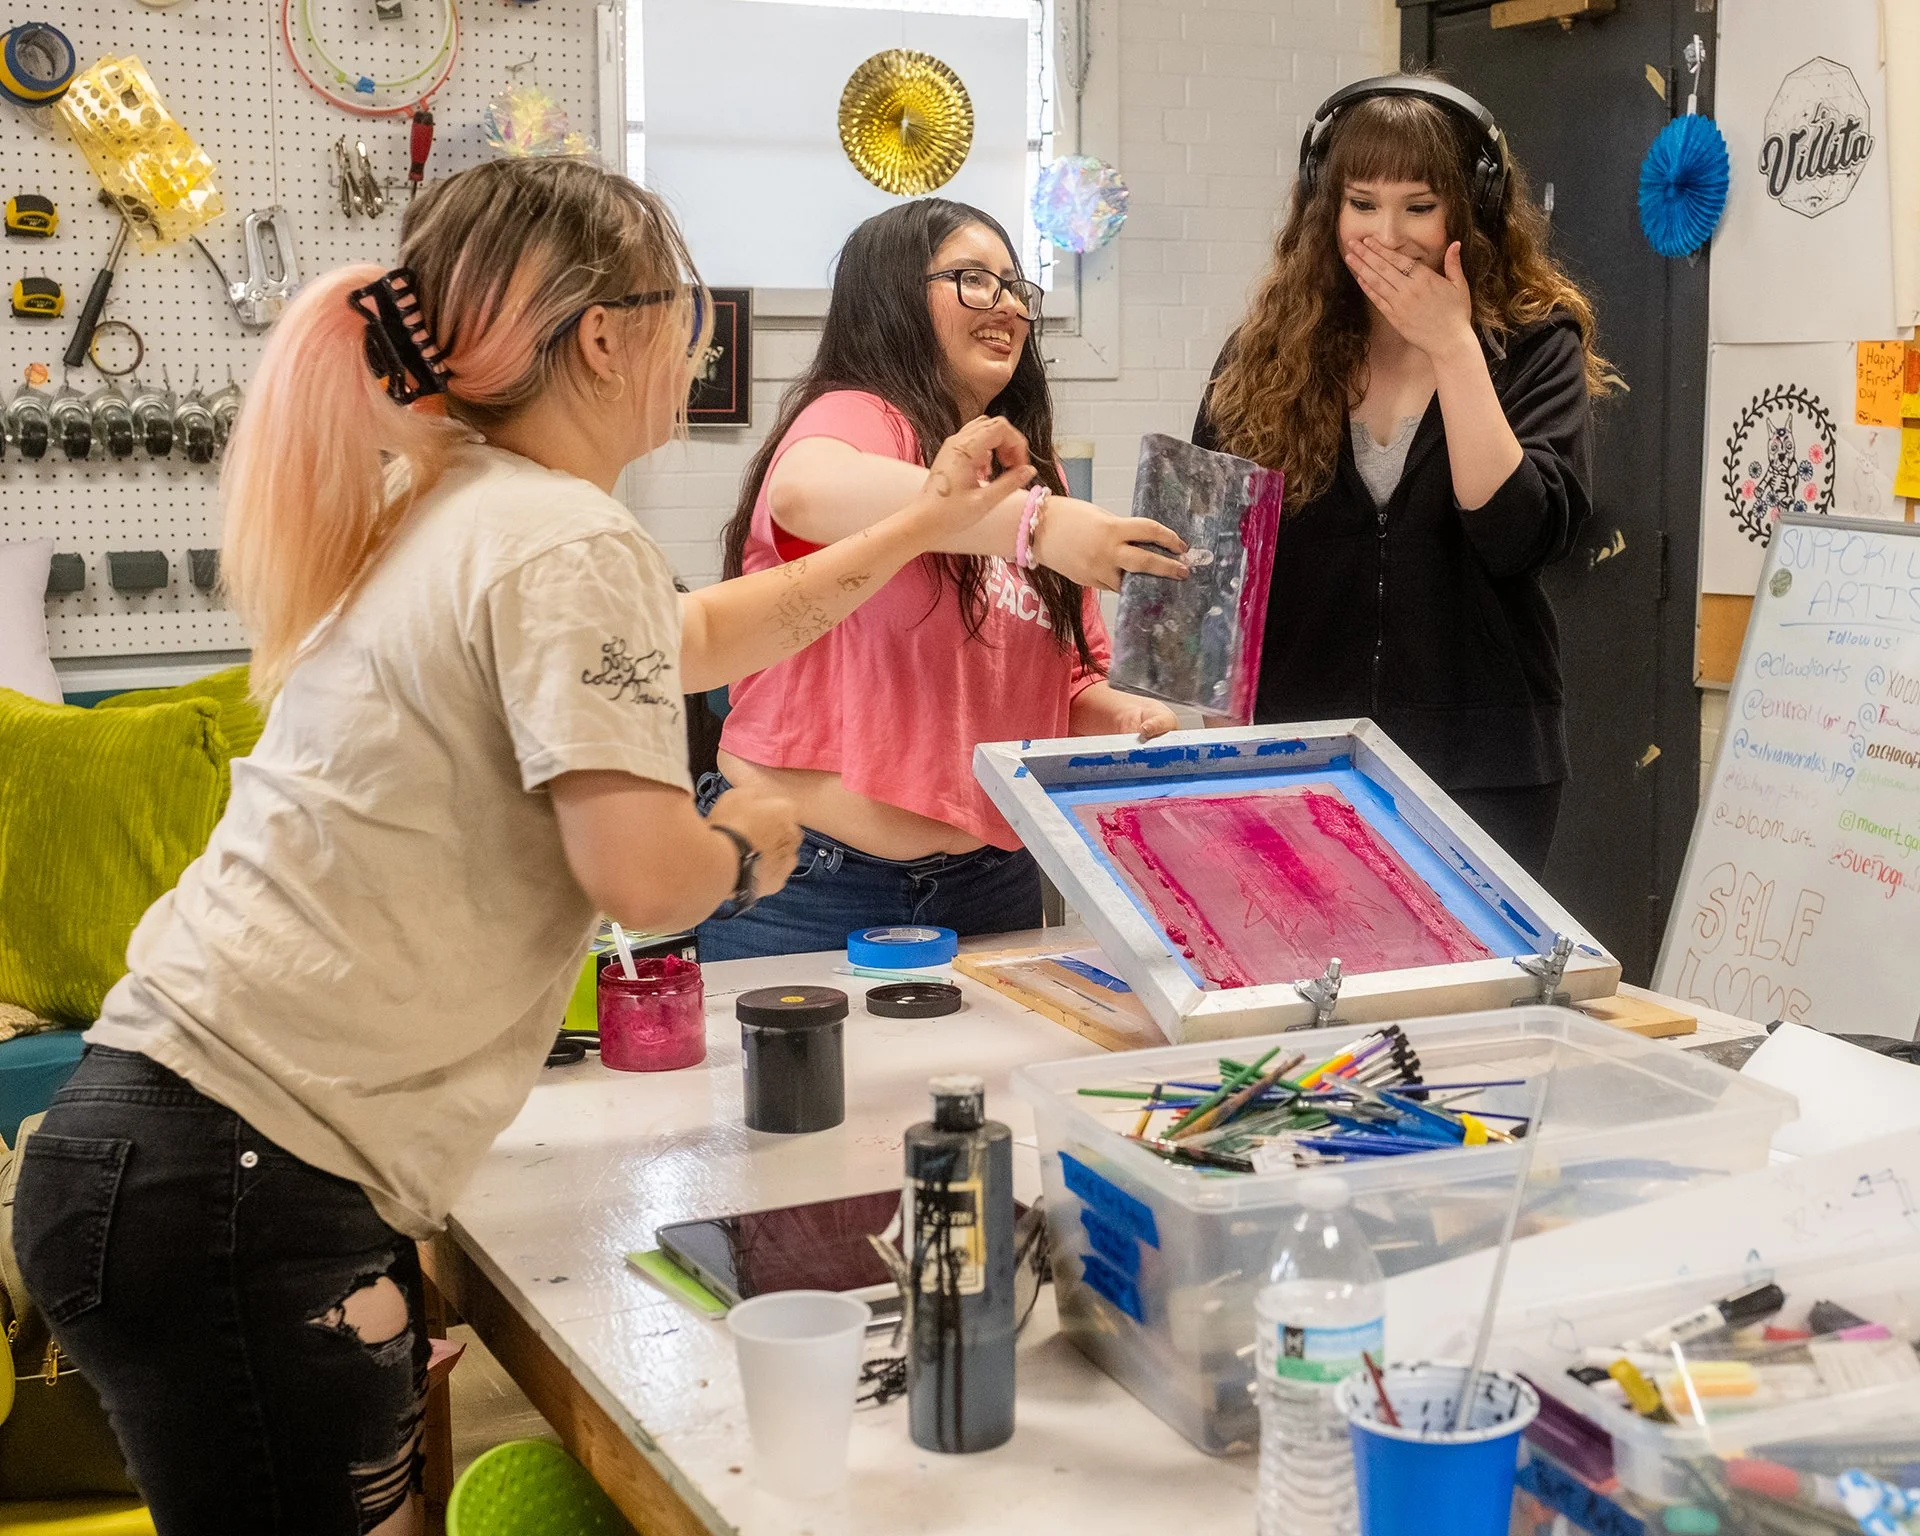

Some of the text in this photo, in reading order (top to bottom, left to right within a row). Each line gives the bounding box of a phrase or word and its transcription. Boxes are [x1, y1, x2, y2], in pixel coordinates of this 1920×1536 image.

[1760, 118, 1873, 197] Villita
[1866, 347, 1896, 370] Happy
[1866, 370, 1892, 387] First
[1859, 387, 1877, 404] Day
[1692, 862, 1825, 966] SELF
